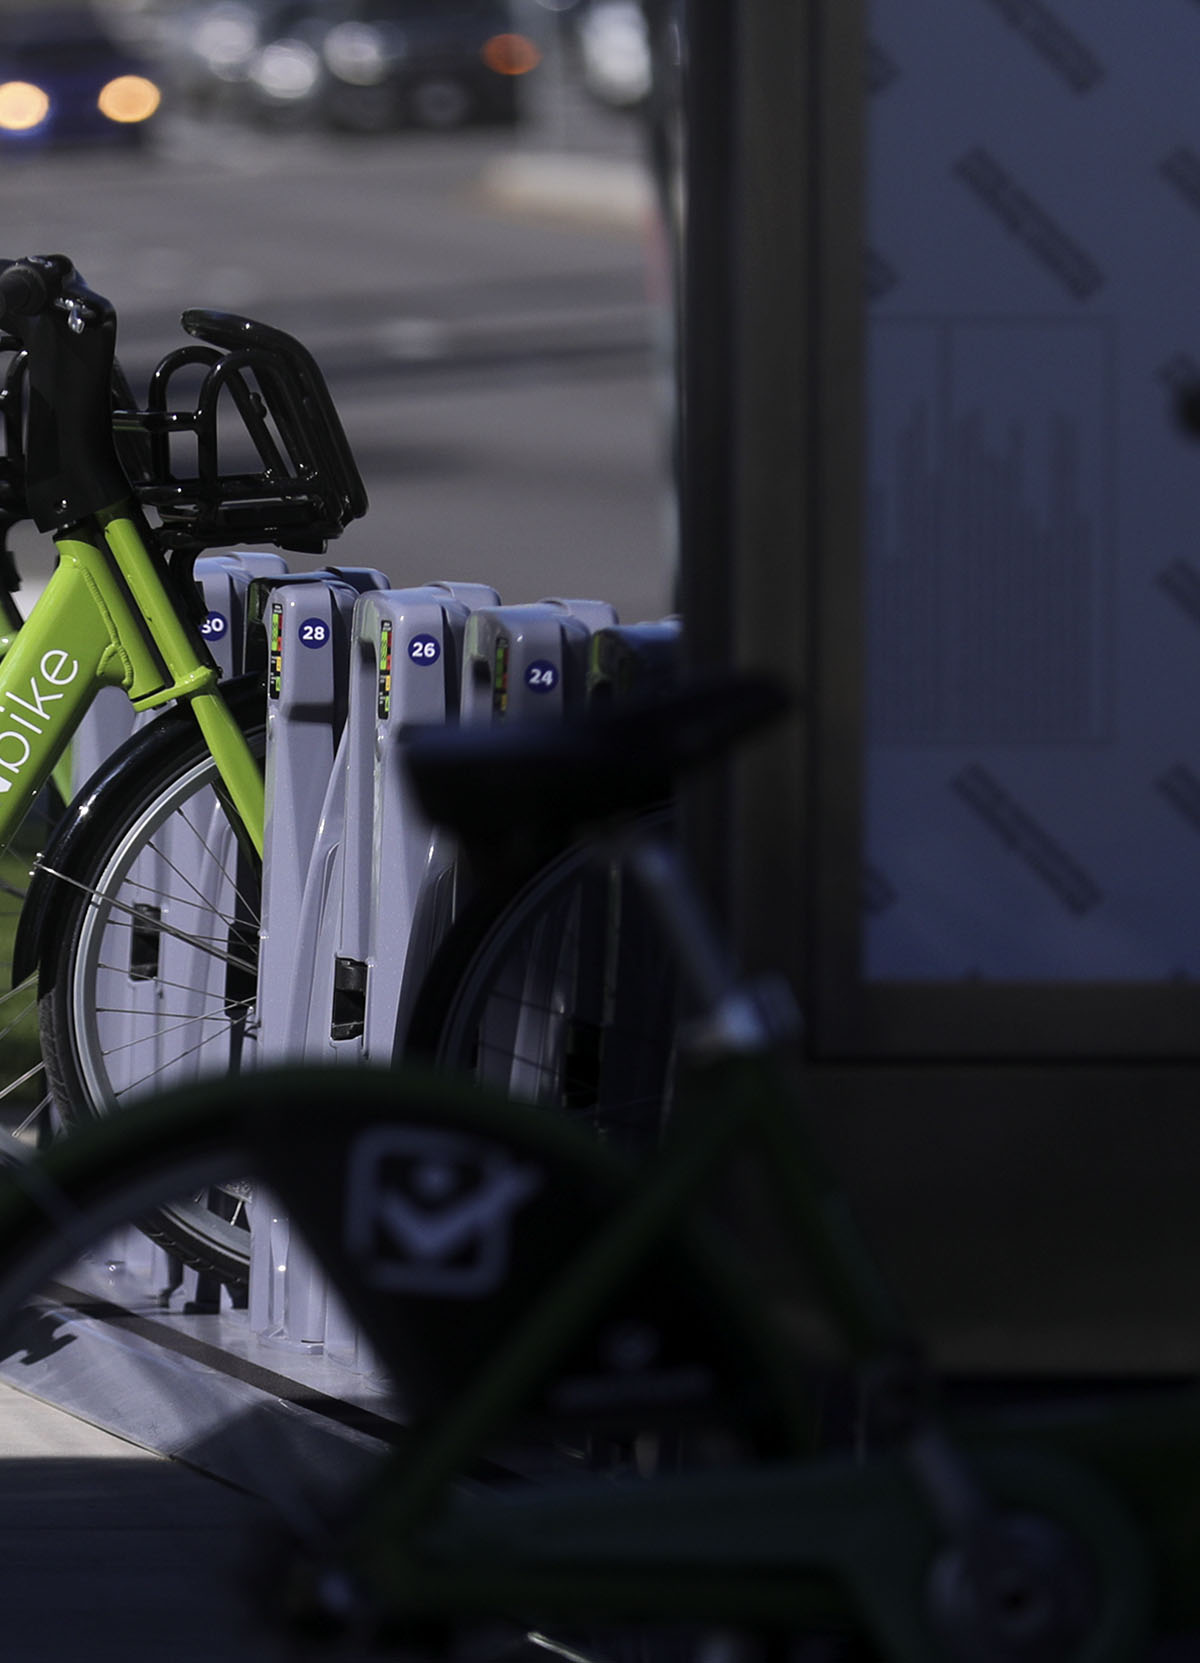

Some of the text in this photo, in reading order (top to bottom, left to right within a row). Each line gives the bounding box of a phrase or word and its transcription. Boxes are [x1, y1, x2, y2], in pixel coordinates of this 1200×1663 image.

[302, 625, 325, 641] 28
[411, 642, 436, 658] 26
[528, 668, 554, 686] 24
